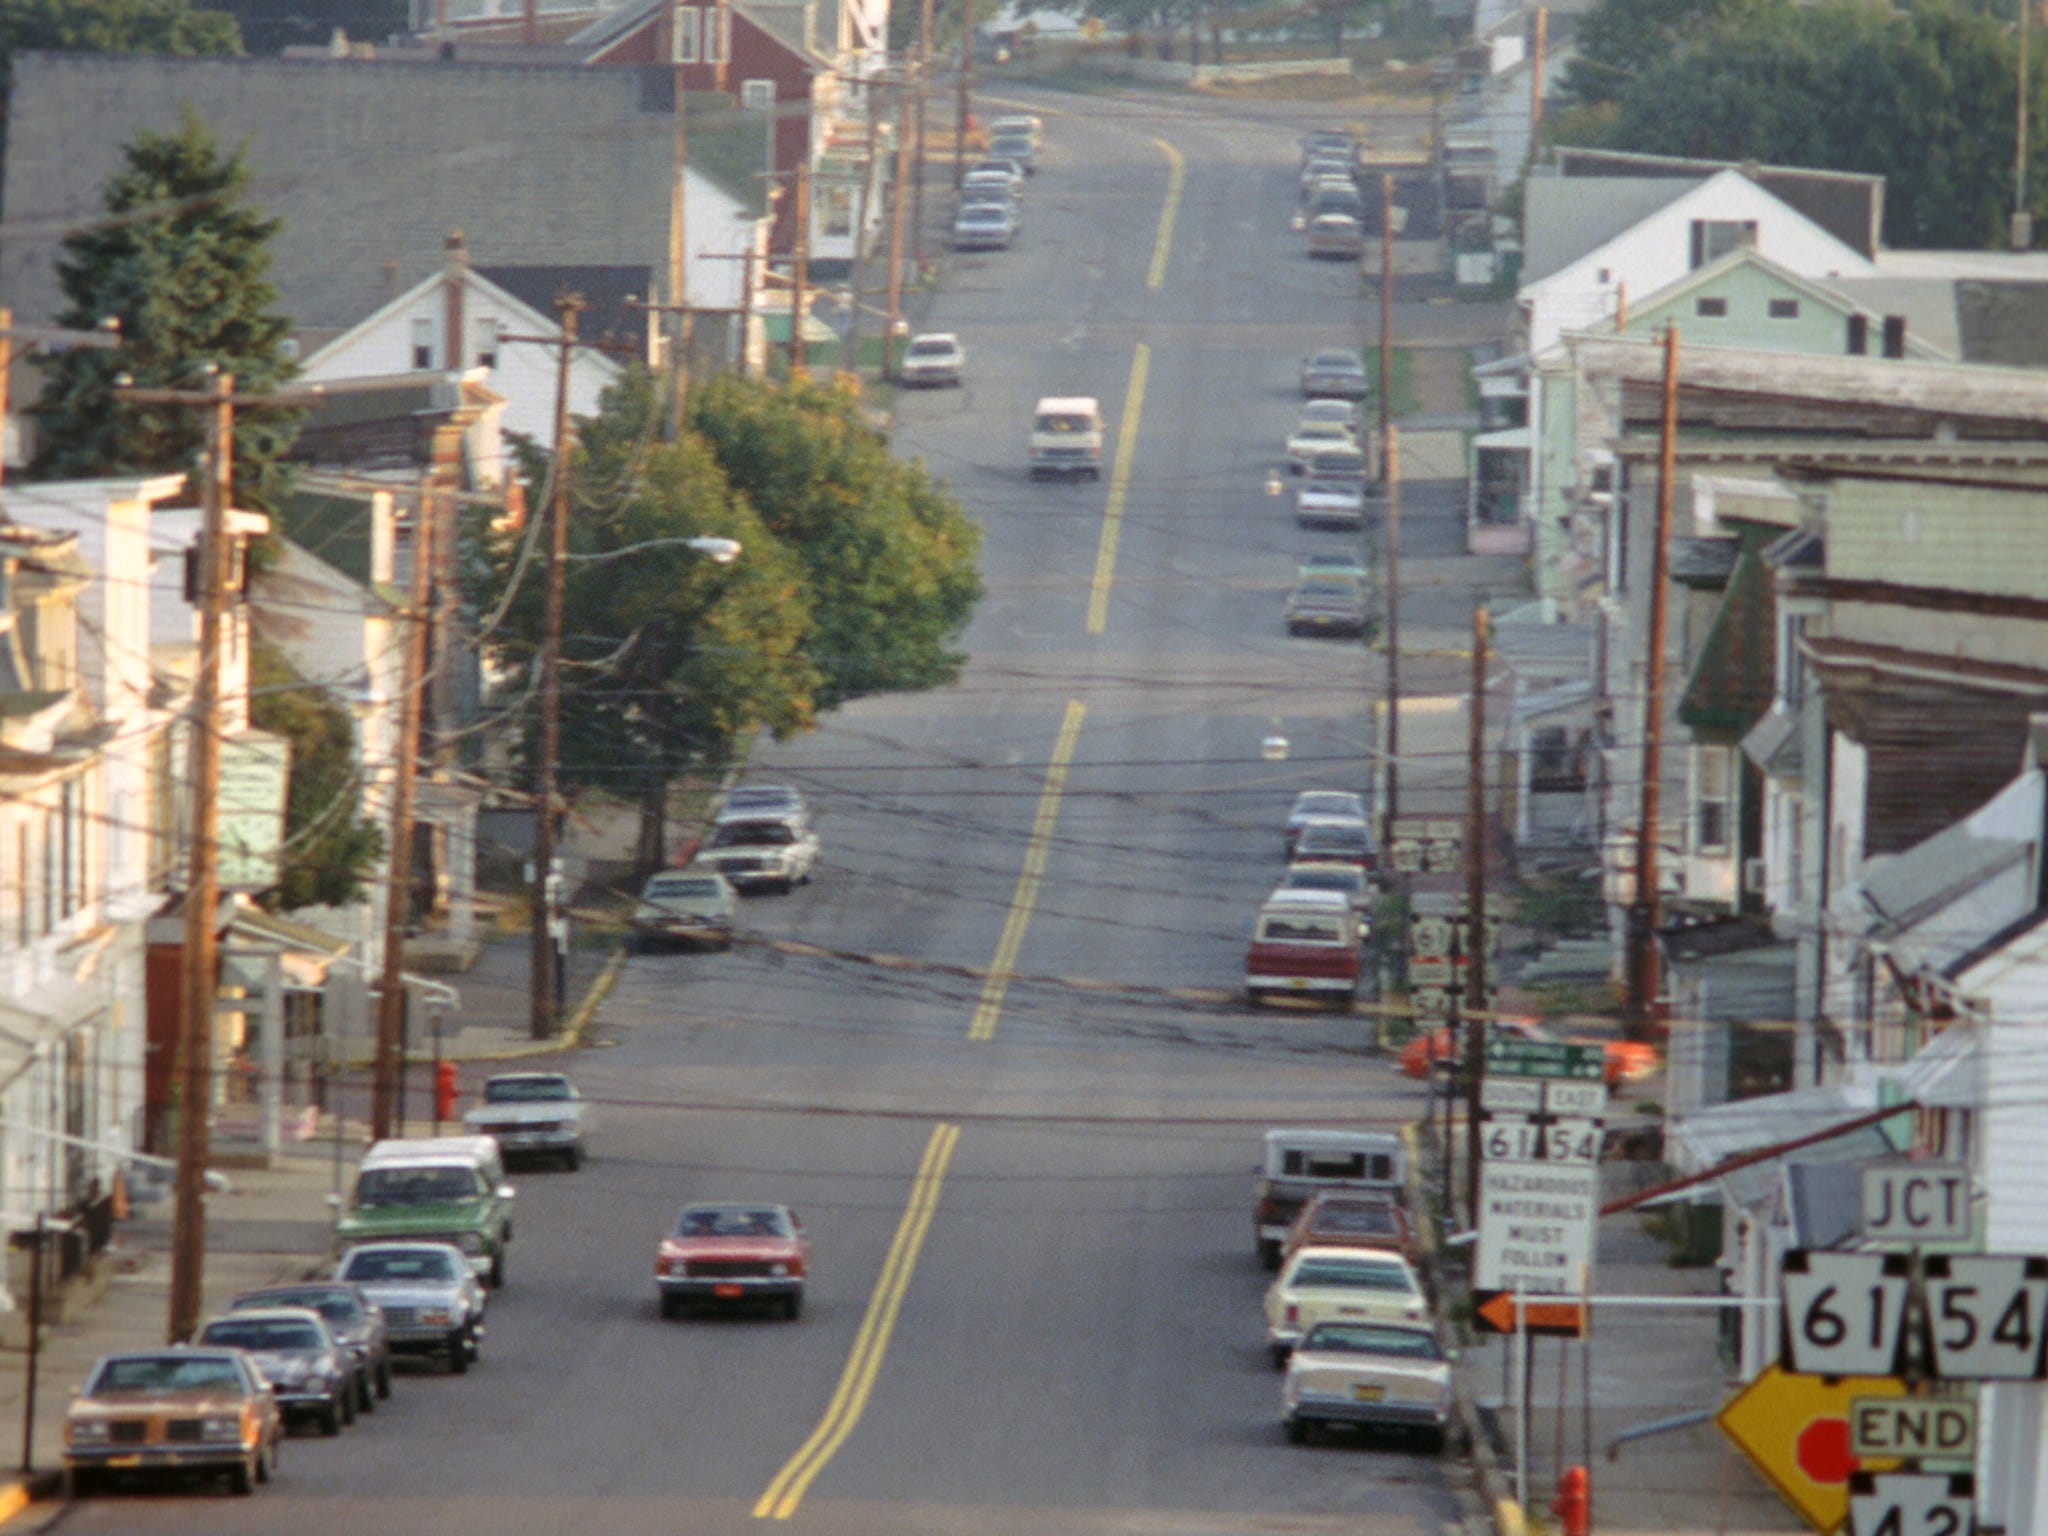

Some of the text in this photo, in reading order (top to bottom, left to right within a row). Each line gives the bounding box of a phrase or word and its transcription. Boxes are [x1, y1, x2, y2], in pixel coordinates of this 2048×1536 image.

[1555, 1088, 1599, 1106] EAST
[1489, 1127, 1528, 1158] 61
[1551, 1130, 1596, 1161] 54
[1487, 1173, 1590, 1196] HAZARDOUS
[1490, 1200, 1586, 1221] MATERIALS
[1868, 1178, 1962, 1229] JCT
[1508, 1224, 1564, 1244] MUST
[1500, 1248, 1567, 1268] FOLLOW
[1804, 1285, 1885, 1349] 61
[1941, 1286, 2032, 1353] 54
[1858, 1408, 1968, 1449] END
